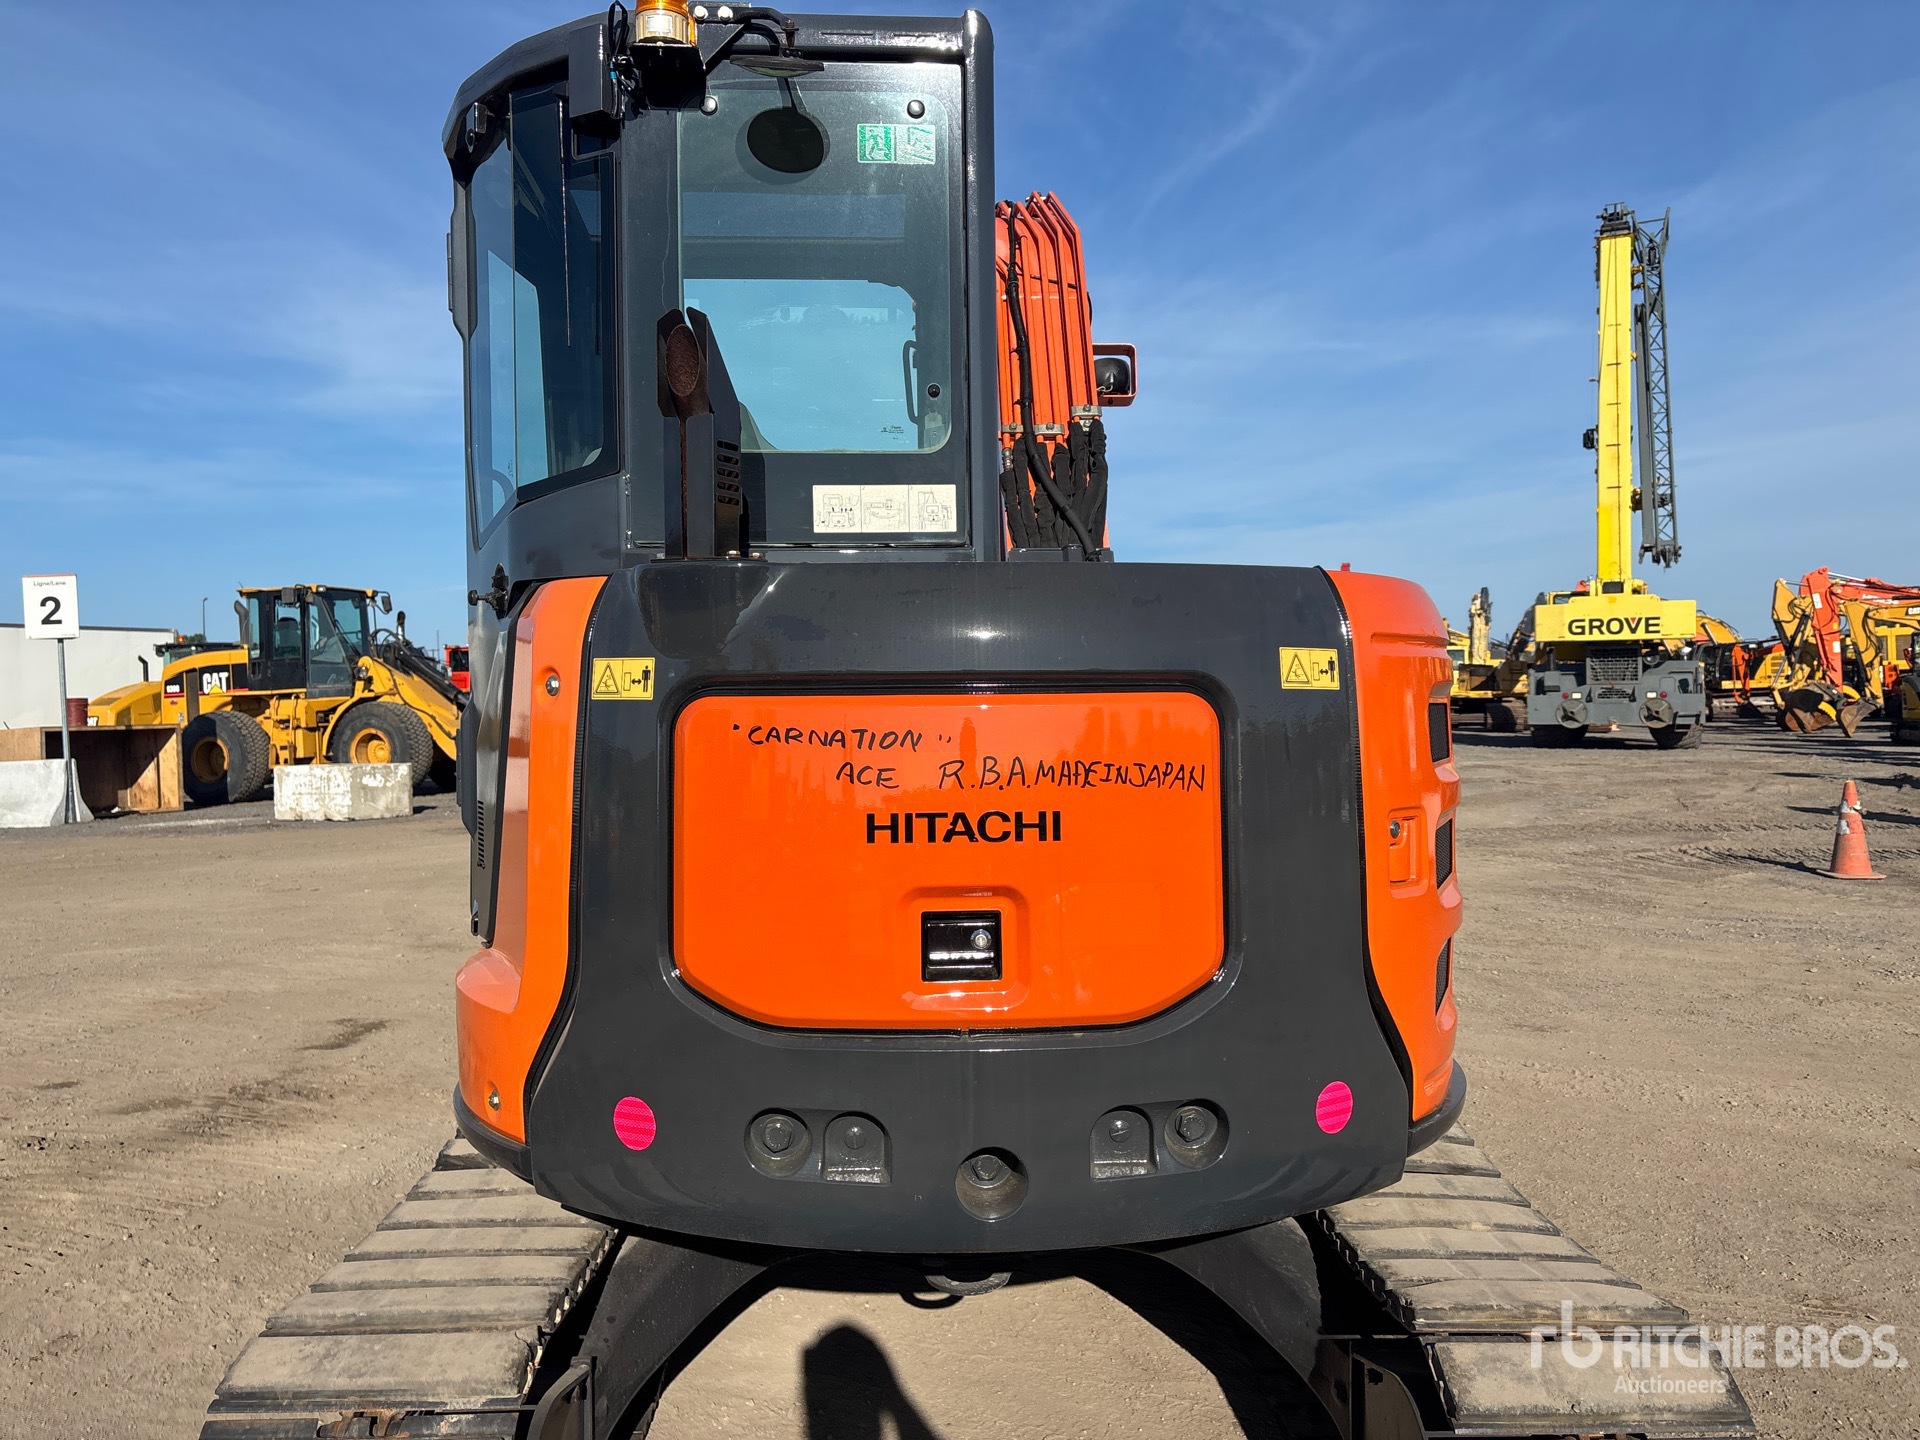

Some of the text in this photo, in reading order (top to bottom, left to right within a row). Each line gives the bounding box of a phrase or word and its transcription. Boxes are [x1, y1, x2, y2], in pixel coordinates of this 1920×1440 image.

[40, 596, 62, 625] 2
[1568, 617, 1660, 635] GROVE
[202, 672, 229, 694] CAT
[836, 761, 900, 789] ACE
[866, 811, 1061, 844] HITACHI
